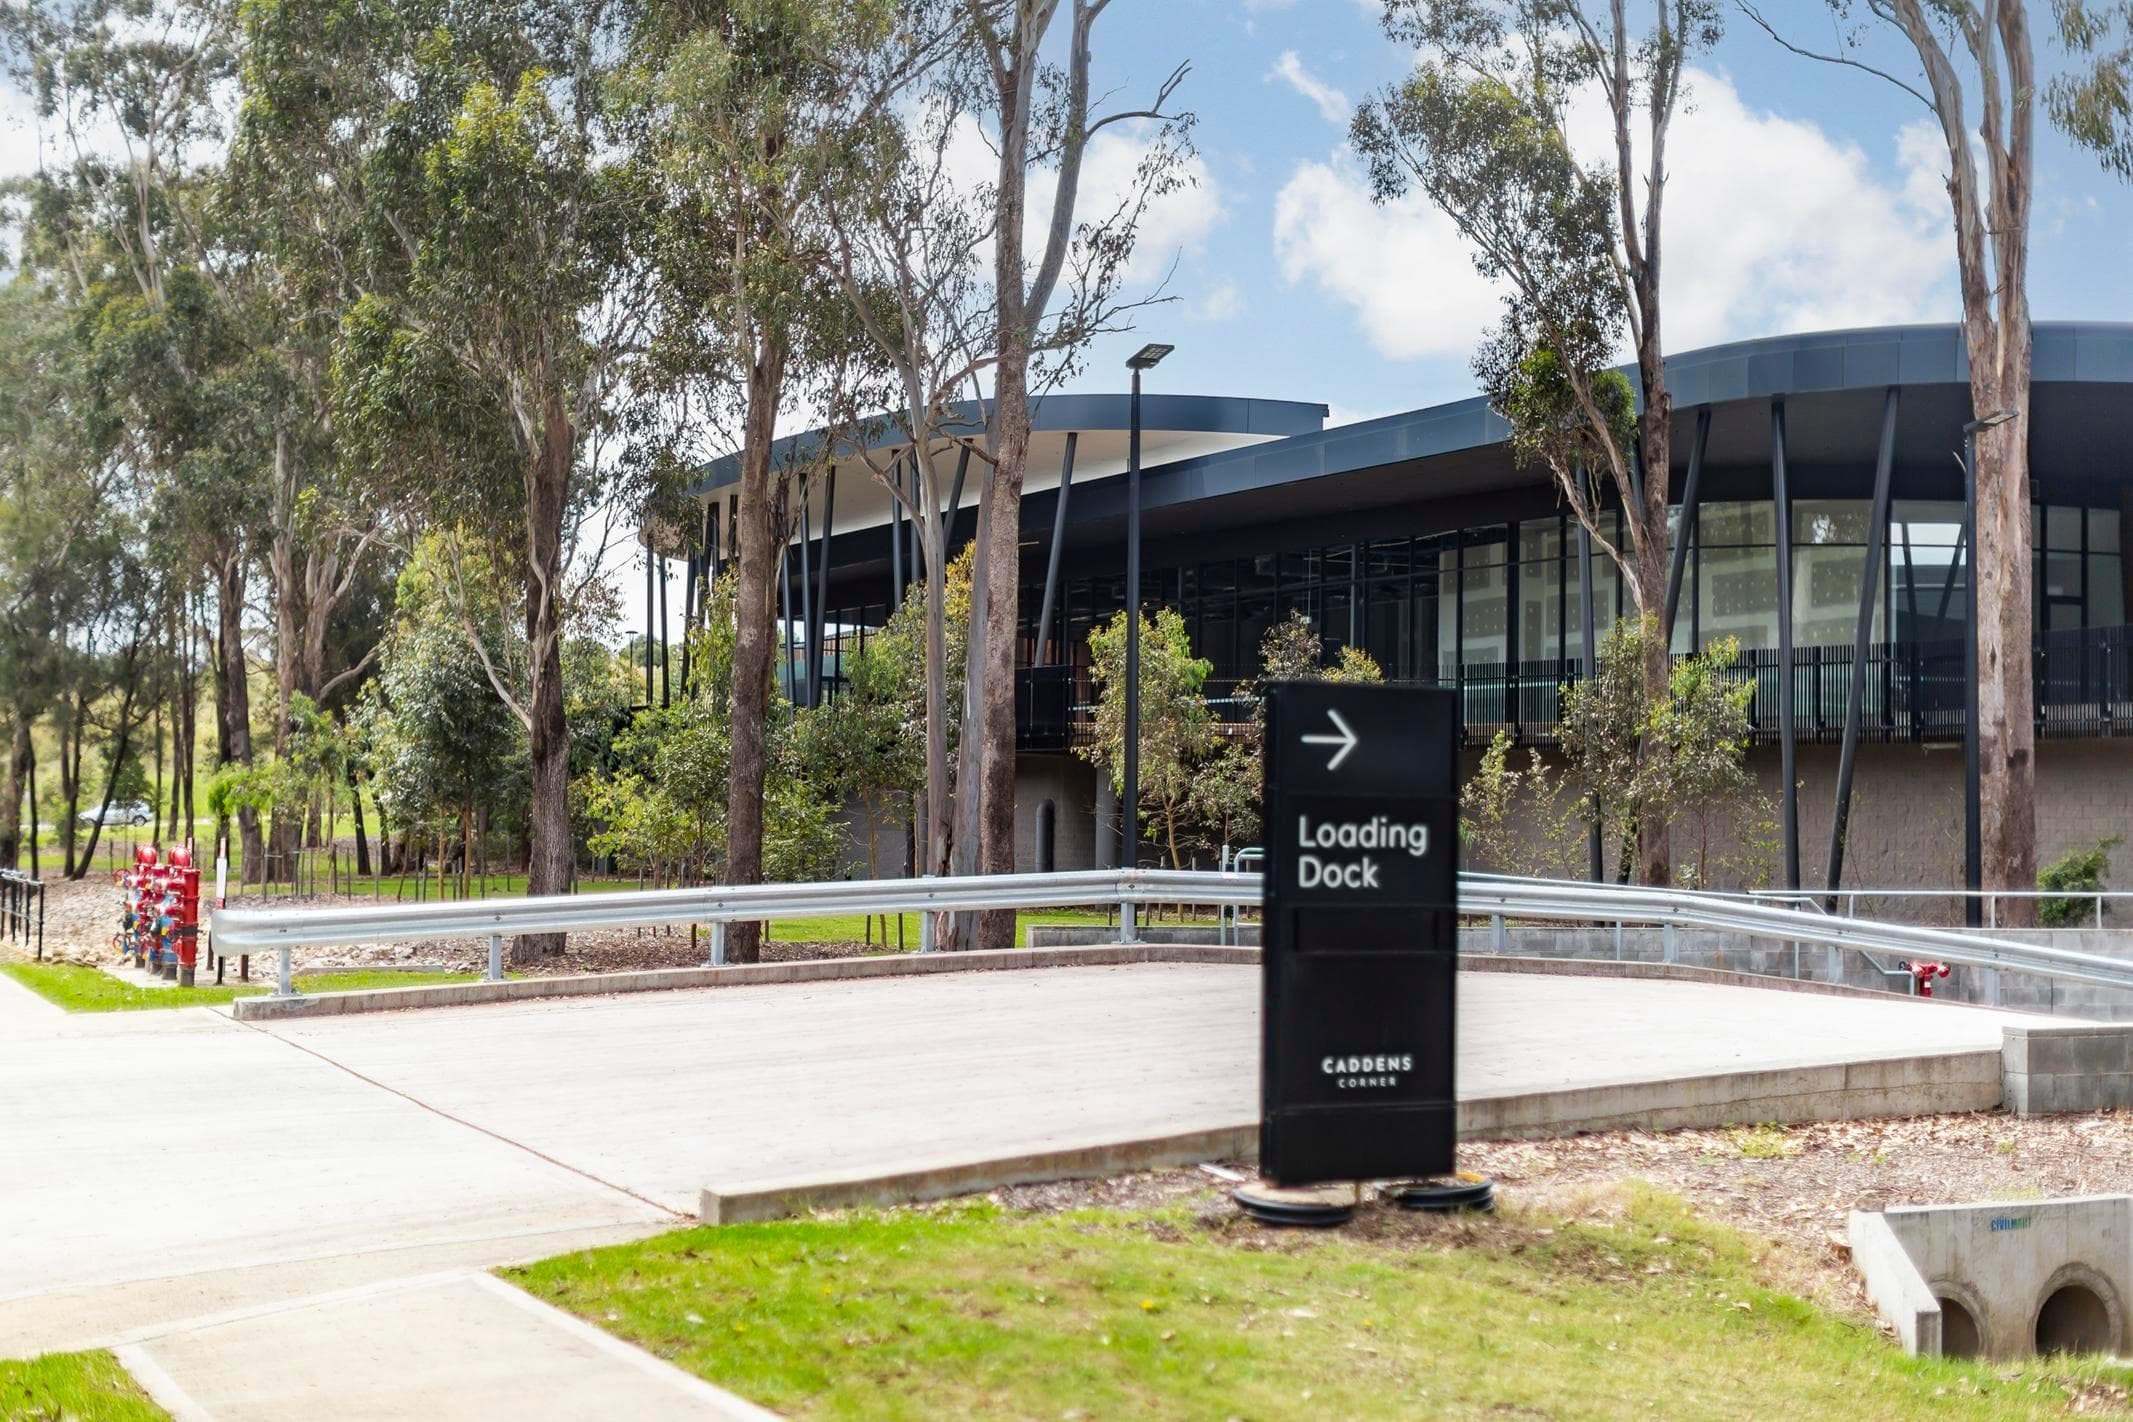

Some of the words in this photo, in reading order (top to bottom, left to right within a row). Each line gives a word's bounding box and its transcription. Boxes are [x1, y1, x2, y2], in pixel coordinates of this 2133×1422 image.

[1298, 814, 1428, 857] Loading
[1298, 854, 1379, 889] Dock
[1320, 1055, 1413, 1074] CADDENS
[1338, 1076, 1397, 1088] CORNER
